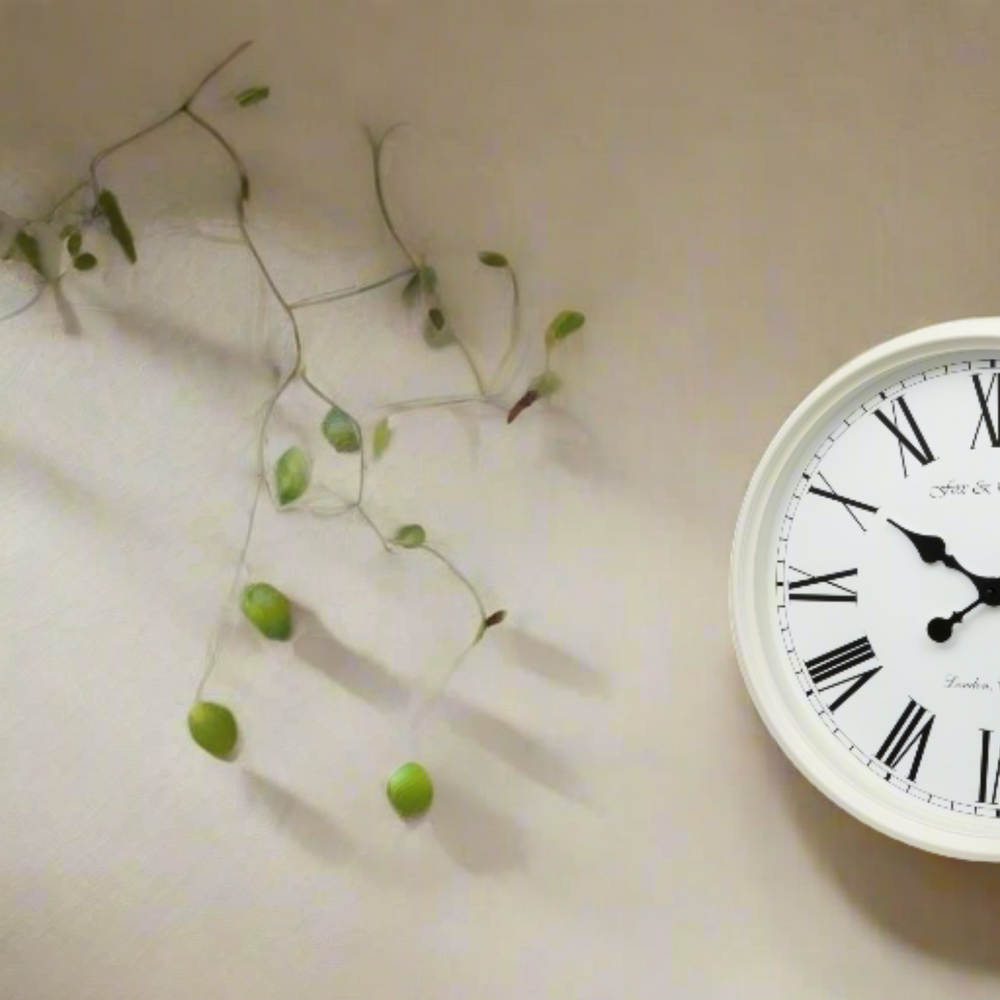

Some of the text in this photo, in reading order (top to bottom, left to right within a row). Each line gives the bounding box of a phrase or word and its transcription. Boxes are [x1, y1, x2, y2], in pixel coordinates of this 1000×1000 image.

[872, 395, 938, 478] XI
[807, 471, 879, 533] X
[929, 479, 968, 498] Fox
[972, 480, 991, 494] &
[788, 565, 858, 606] IX
[874, 695, 936, 783] VII
